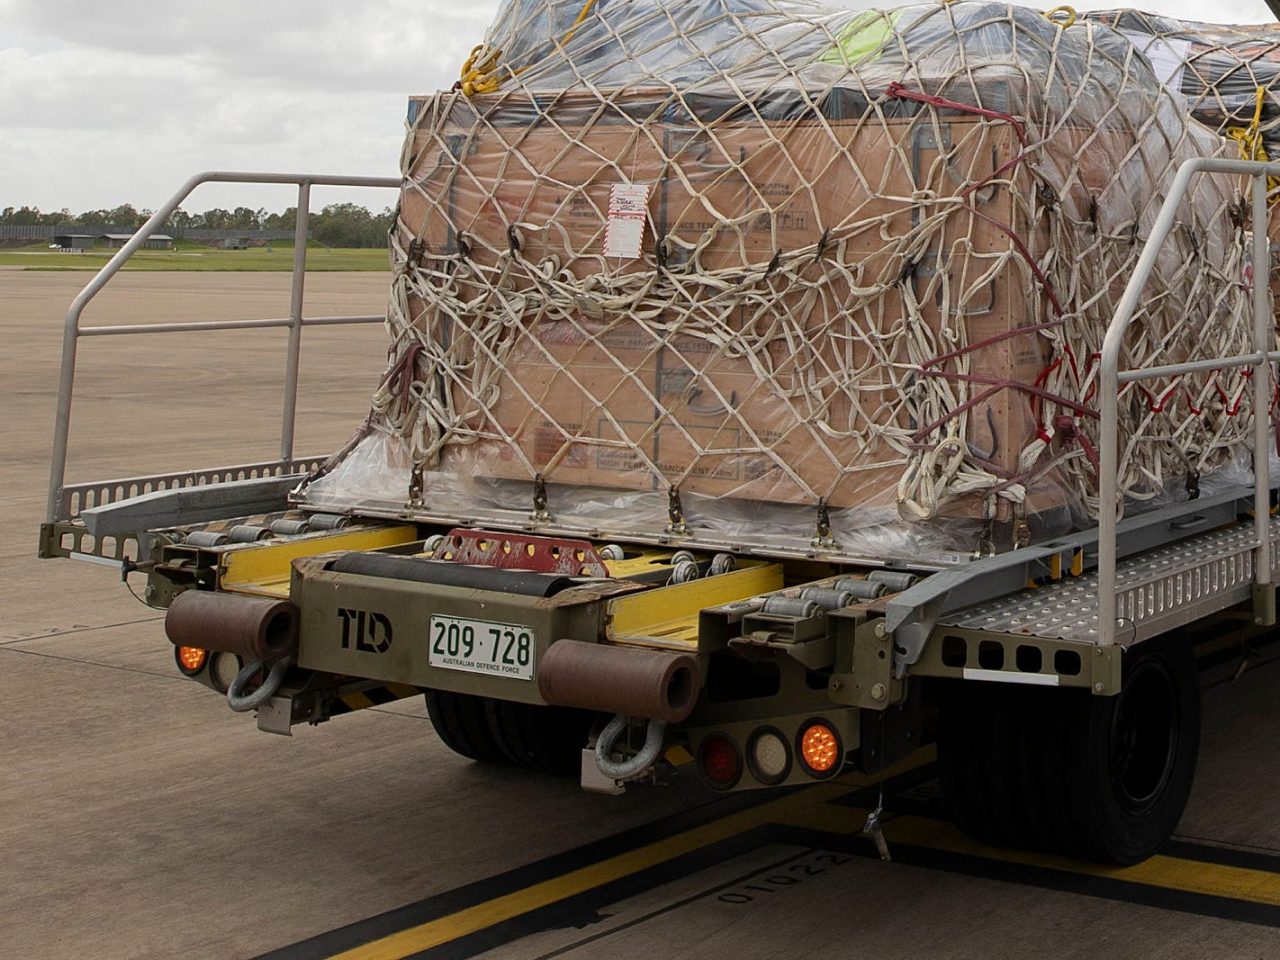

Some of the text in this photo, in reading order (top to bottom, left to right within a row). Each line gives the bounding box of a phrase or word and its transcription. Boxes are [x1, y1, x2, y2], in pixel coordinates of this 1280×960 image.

[337, 607, 394, 654] TLD
[433, 621, 530, 667] 209 728
[442, 656, 520, 675] AUSTRALIAN DEFENCE FORCE
